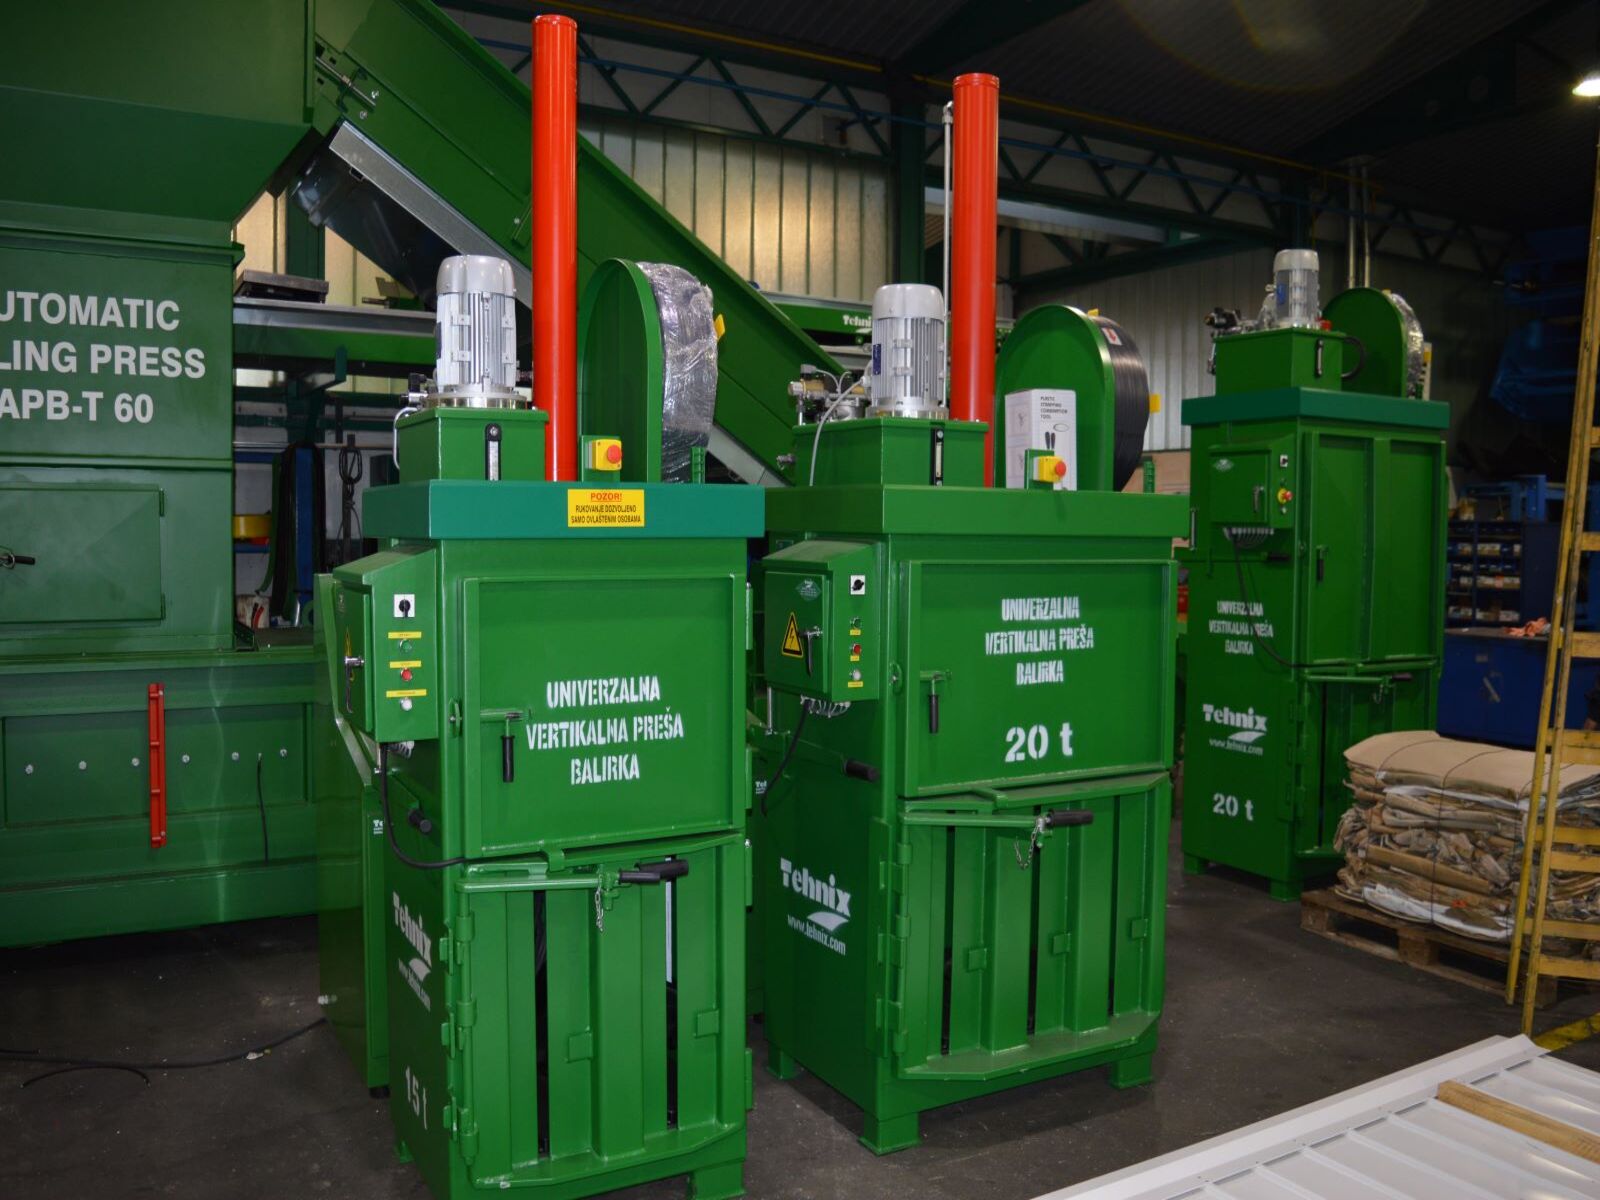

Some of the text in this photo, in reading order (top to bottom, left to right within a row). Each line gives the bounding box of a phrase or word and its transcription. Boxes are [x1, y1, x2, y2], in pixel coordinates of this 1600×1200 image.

[90, 343, 206, 379] PRESS
[0, 388, 154, 423] APB-T 60
[575, 504, 637, 513] RUKOVANJE DOZVOLJENO
[591, 492, 623, 501] POZOR!
[571, 515, 586, 524] SAMO
[617, 515, 641, 523] OSOBAMA
[1001, 596, 1080, 621] UNIVERZALNA
[985, 623, 1094, 655] VERTIKALNA PREŠA
[1208, 619, 1250, 636] VERTIKALNA
[1016, 660, 1064, 686] BALIRKA
[546, 675, 661, 709] UNIVERZALNA
[525, 706, 684, 750] VERTIKALNA PREŠA
[1202, 703, 1267, 732] Tehnix
[1005, 722, 1073, 763] 20 t
[570, 753, 640, 786] BALIRKA
[1212, 792, 1254, 821] 20 t
[780, 856, 851, 918] Tehnix
[392, 890, 432, 969] Tehnix
[787, 914, 846, 956] www.tehnix.com
[405, 1065, 420, 1117] 15
